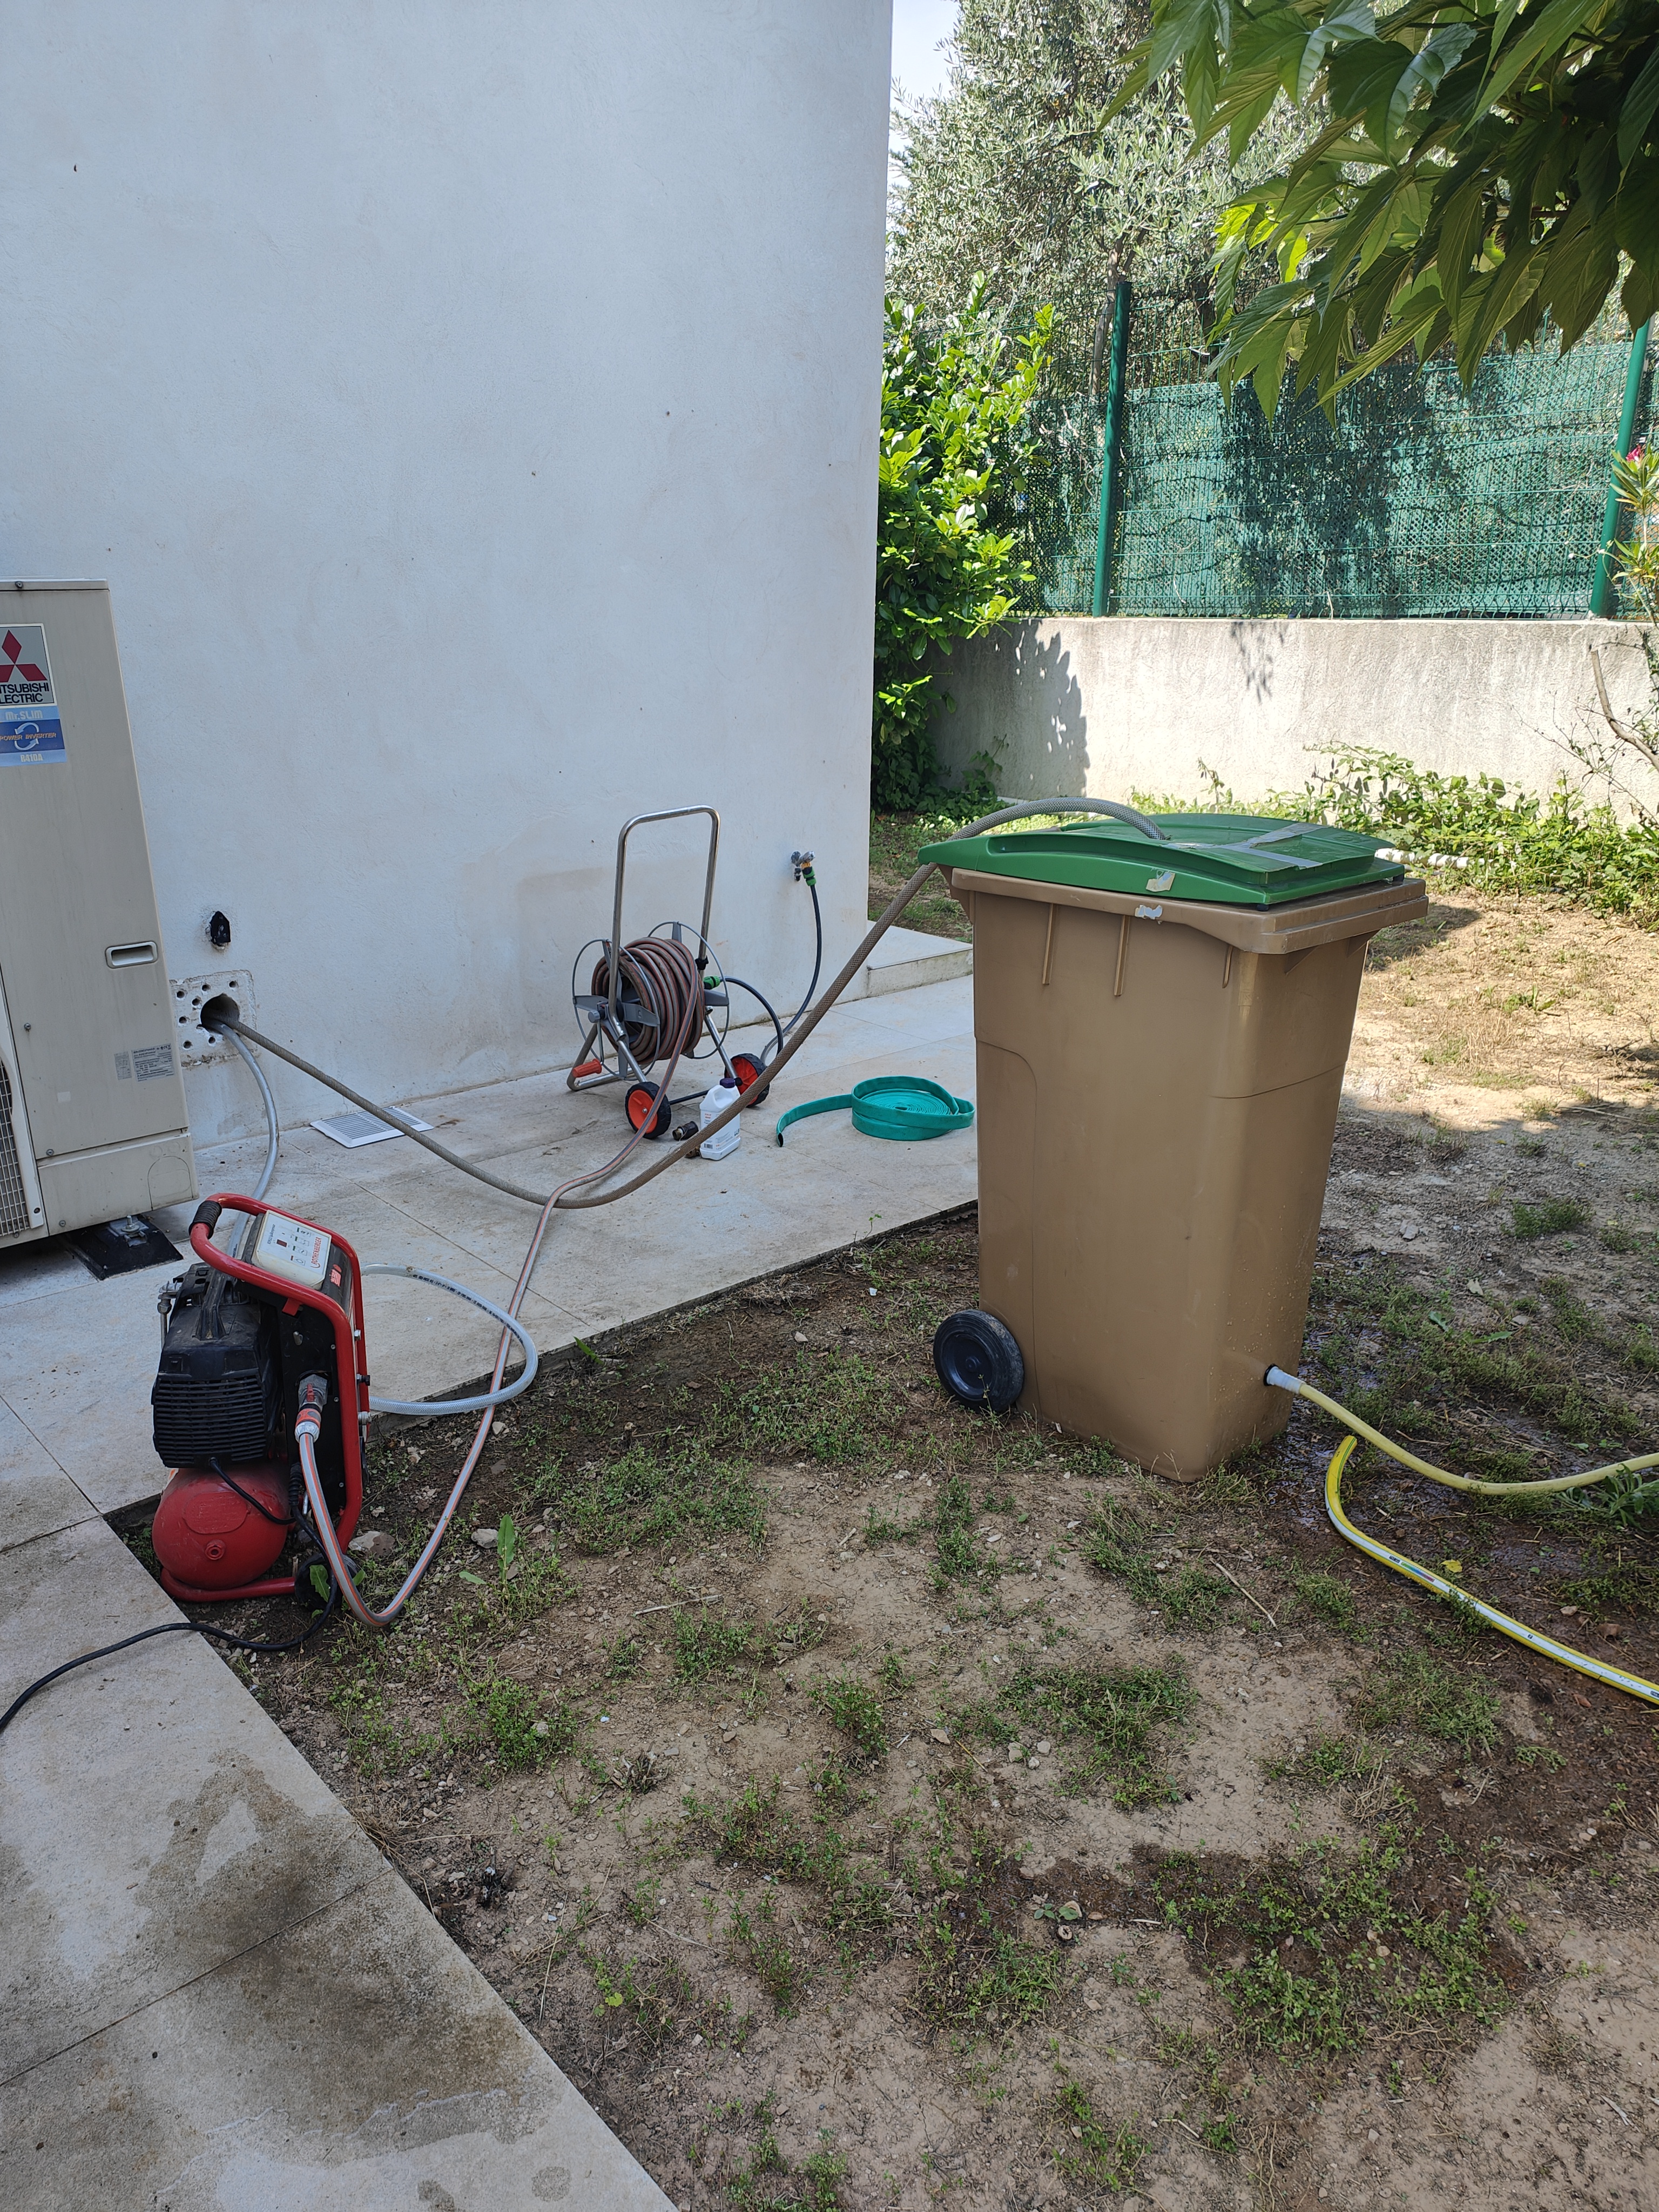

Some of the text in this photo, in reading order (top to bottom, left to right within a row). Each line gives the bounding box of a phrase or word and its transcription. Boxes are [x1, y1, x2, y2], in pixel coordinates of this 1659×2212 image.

[0, 683, 50, 693] ITSUBISHI
[0, 693, 43, 704] LECTRIC
[311, 1237, 322, 1268] ROTHENBERGER
